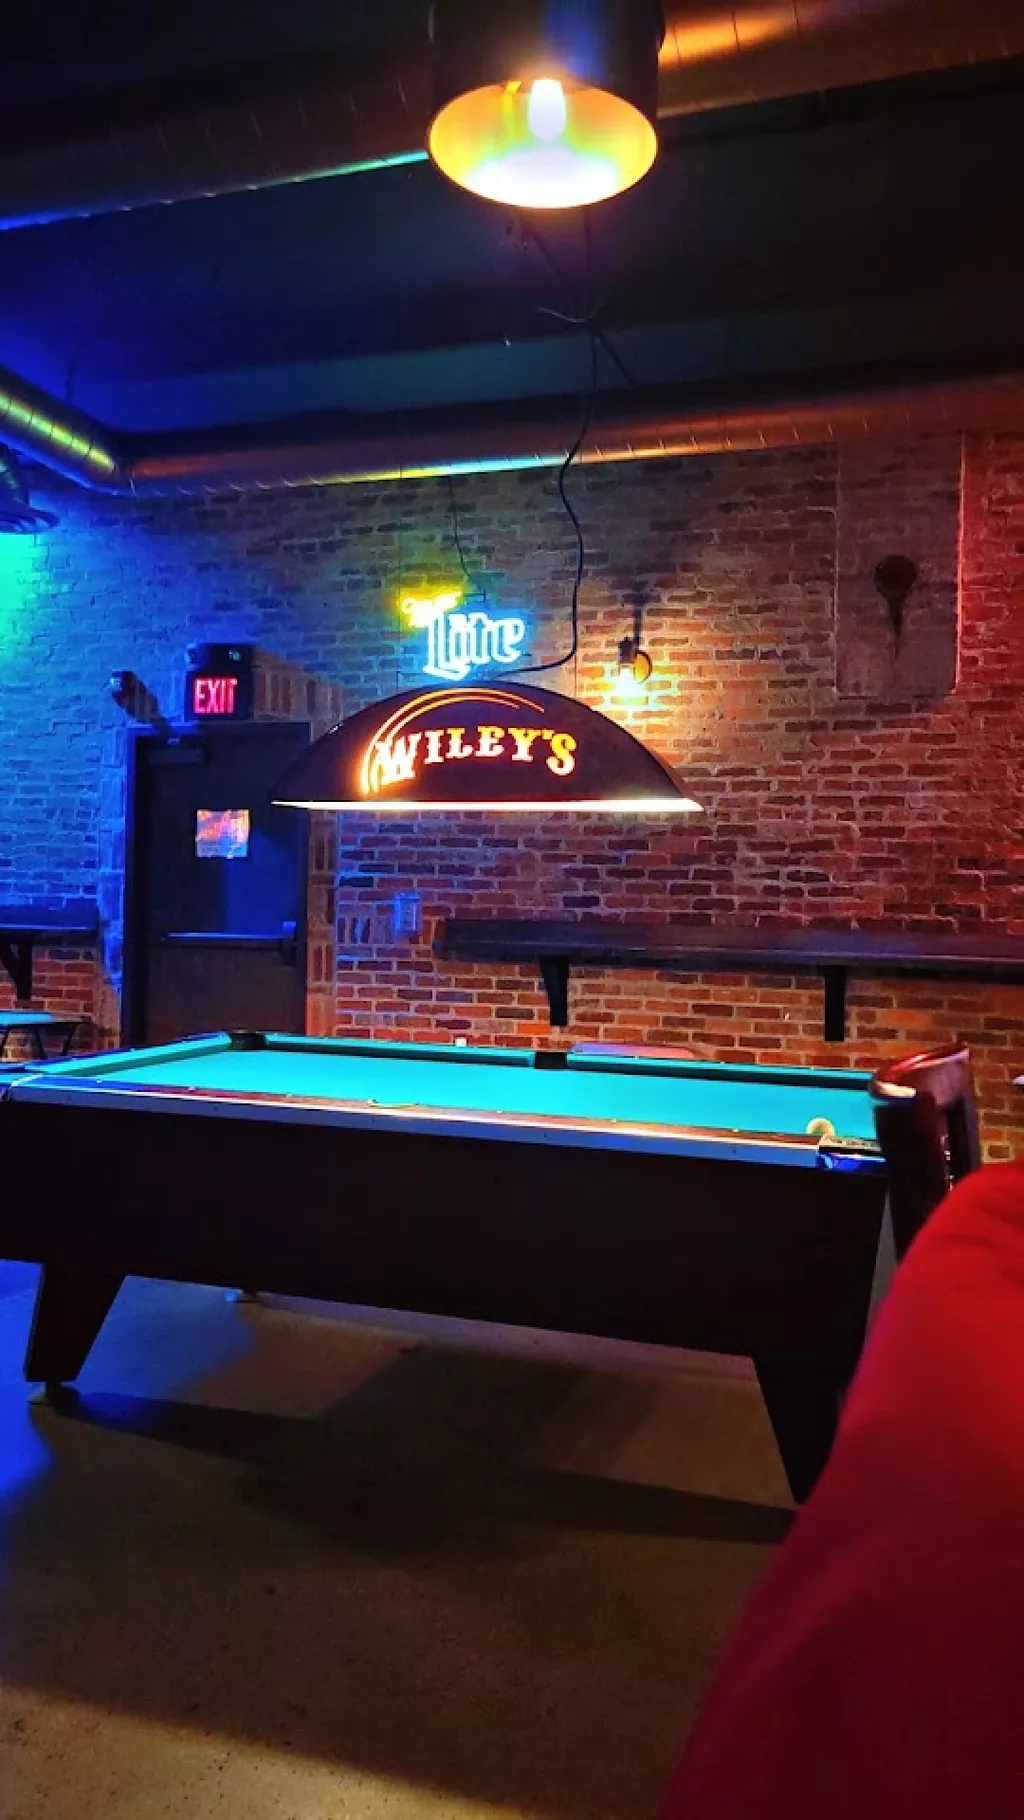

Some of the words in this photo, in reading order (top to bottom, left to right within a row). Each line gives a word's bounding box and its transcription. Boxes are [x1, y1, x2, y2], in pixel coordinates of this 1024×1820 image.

[423, 612, 525, 681] Lite
[193, 678, 238, 714] EXIT
[375, 725, 577, 786] WILEY'S
